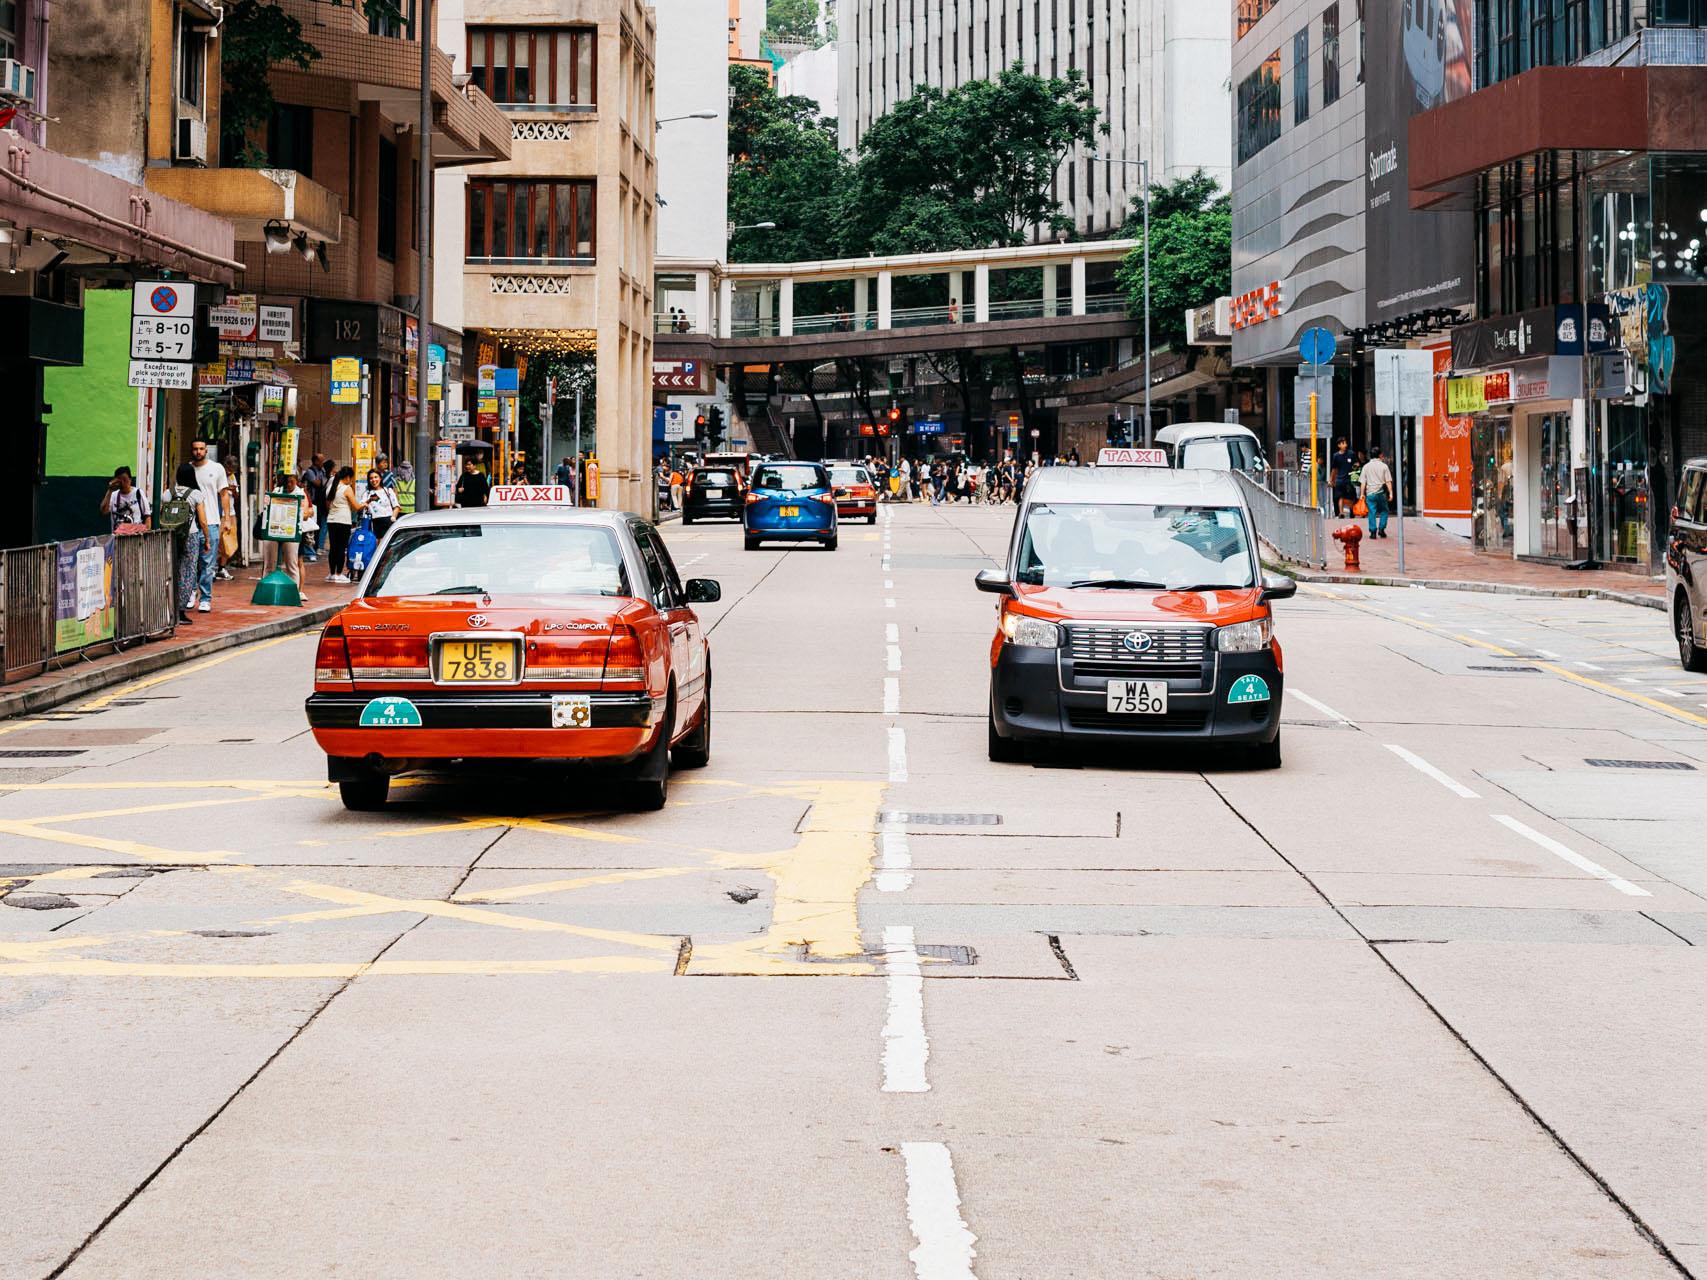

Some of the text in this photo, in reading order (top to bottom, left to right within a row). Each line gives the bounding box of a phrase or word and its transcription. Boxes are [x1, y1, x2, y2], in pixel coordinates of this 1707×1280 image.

[1229, 280, 1281, 331] PORSCHE
[156, 323, 190, 335] 8-10
[335, 320, 361, 341] 182
[685, 363, 693, 372] P
[1105, 450, 1163, 462] TAXI
[496, 488, 562, 501] TAXI
[464, 643, 493, 661] UE
[448, 661, 506, 678] 7838
[1126, 682, 1149, 697] WA
[1246, 683, 1254, 693] 4
[384, 705, 396, 716] 4
[1112, 697, 1162, 712] 7550
